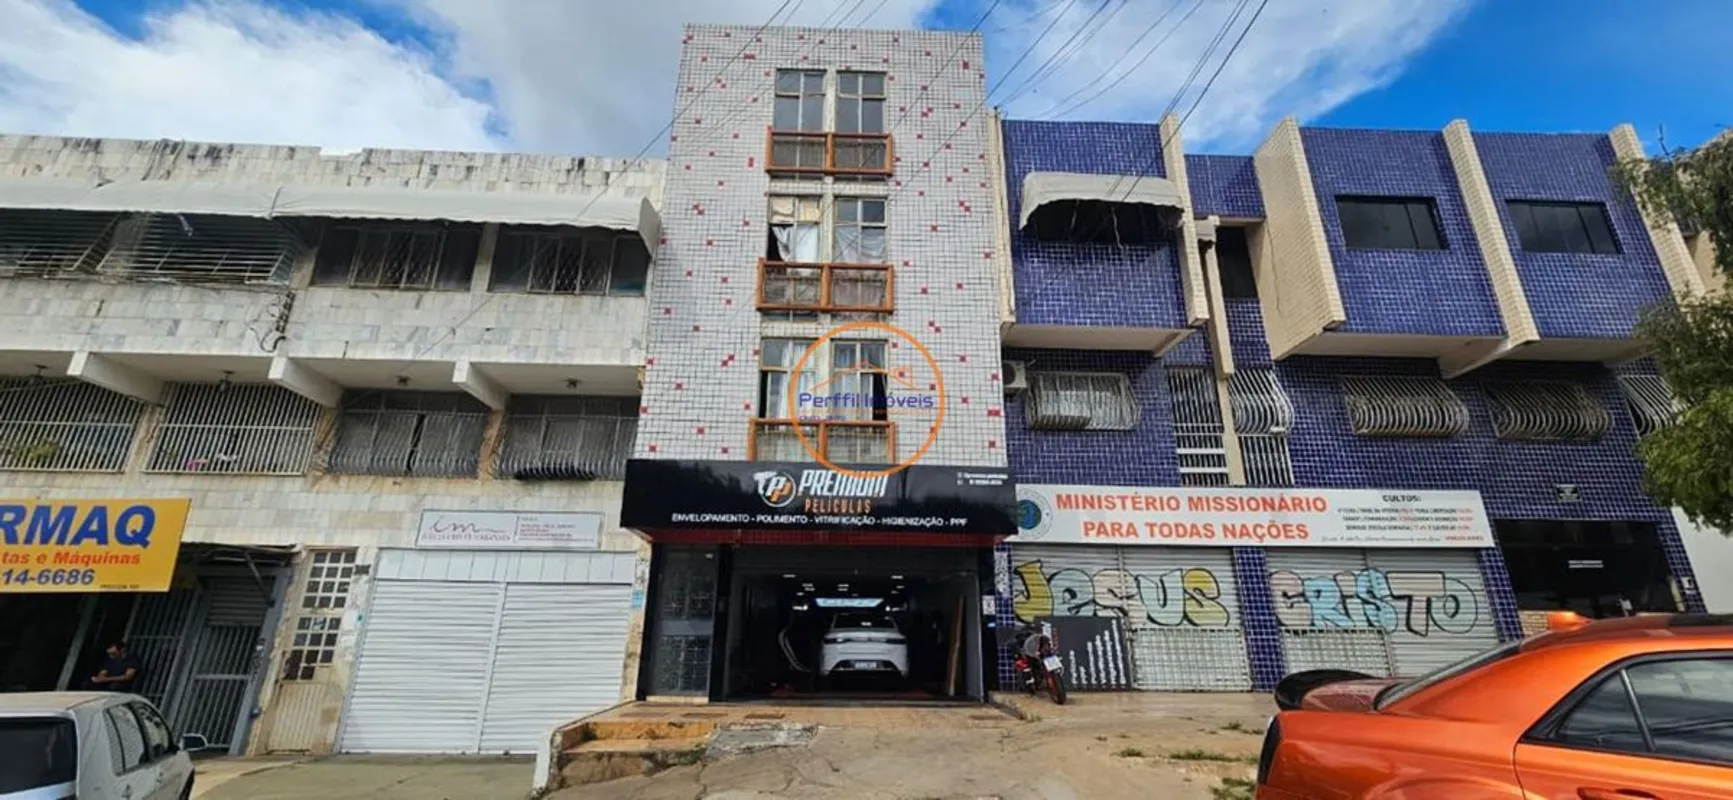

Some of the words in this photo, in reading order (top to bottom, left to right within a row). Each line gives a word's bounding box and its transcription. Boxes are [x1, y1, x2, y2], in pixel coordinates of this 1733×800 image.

[797, 469, 889, 497] PREMIUM
[1056, 491, 1181, 511] MINISTÉRIO
[1187, 493, 1328, 513] MISSIONÁRIO
[671, 512, 750, 523] ENVELOPAMENTO
[756, 514, 808, 524] POLIMENTO
[814, 514, 875, 526] VITRIFICAÇÃO
[881, 517, 944, 528] HIGIENIZAÇÃO
[1083, 520, 1139, 538] PARA
[1145, 521, 1216, 538] TODAS
[1222, 519, 1310, 543] NAÇÕES
[36, 553, 47, 564] e
[53, 549, 140, 567] Máquinas
[2, 568, 95, 585] 14-6686
